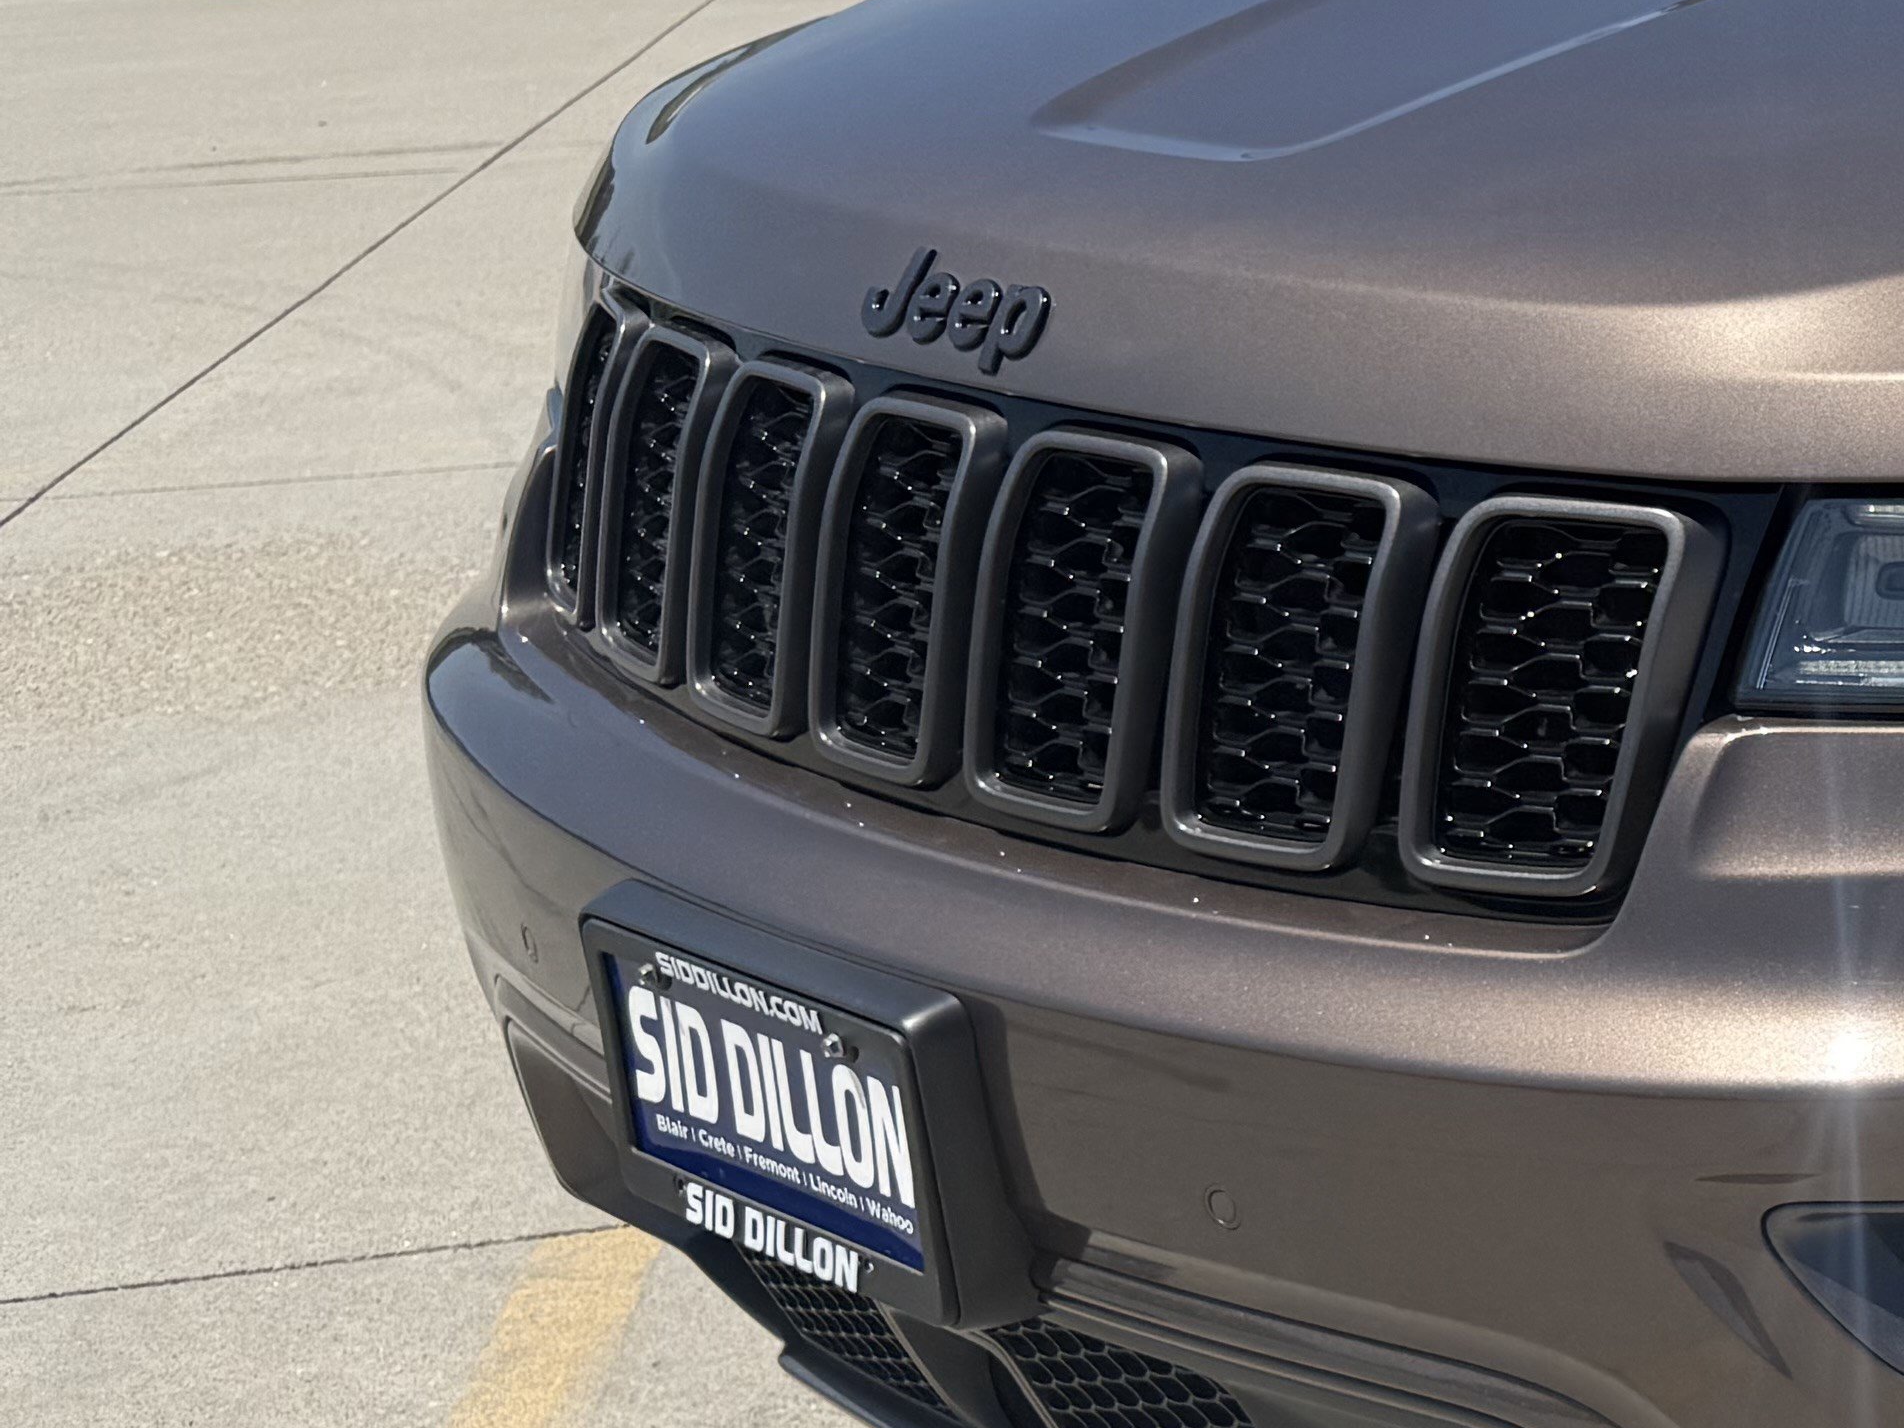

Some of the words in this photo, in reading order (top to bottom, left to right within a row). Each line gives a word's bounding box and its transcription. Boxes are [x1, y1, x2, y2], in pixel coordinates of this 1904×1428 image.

[861, 246, 1052, 377] Jeep
[655, 950, 823, 1035] SIDDILLON.COM
[628, 985, 719, 1124] SID
[720, 1017, 915, 1209] DILLON
[656, 1113, 688, 1139] Blair
[699, 1129, 735, 1158] Crete
[744, 1146, 800, 1184] Fremont
[809, 1173, 857, 1209] Lincoln
[867, 1197, 914, 1235] Wahoo
[685, 1182, 735, 1240] SID
[744, 1206, 859, 1293] DILLON
